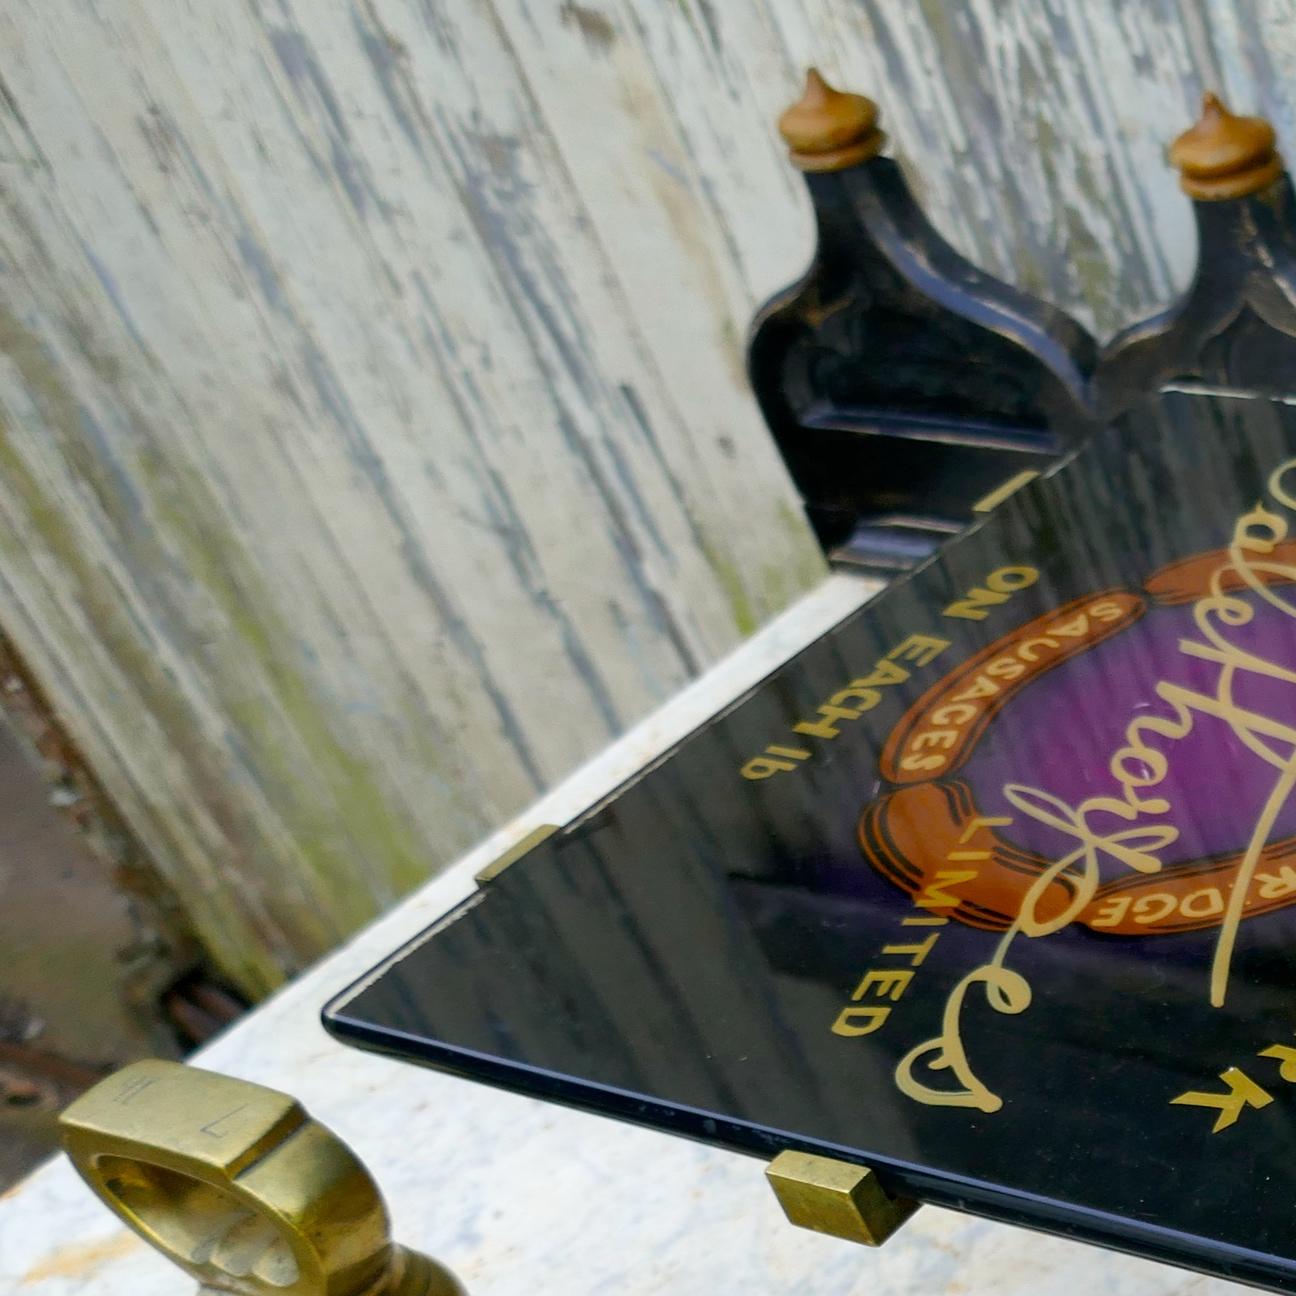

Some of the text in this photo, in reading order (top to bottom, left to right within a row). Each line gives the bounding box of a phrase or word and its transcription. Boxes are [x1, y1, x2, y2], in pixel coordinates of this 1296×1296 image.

[942, 565, 1040, 621] ON
[792, 634, 951, 739] EACH
[899, 603, 1123, 772] SAUSAGES
[830, 816, 1013, 1038] LIMITED
